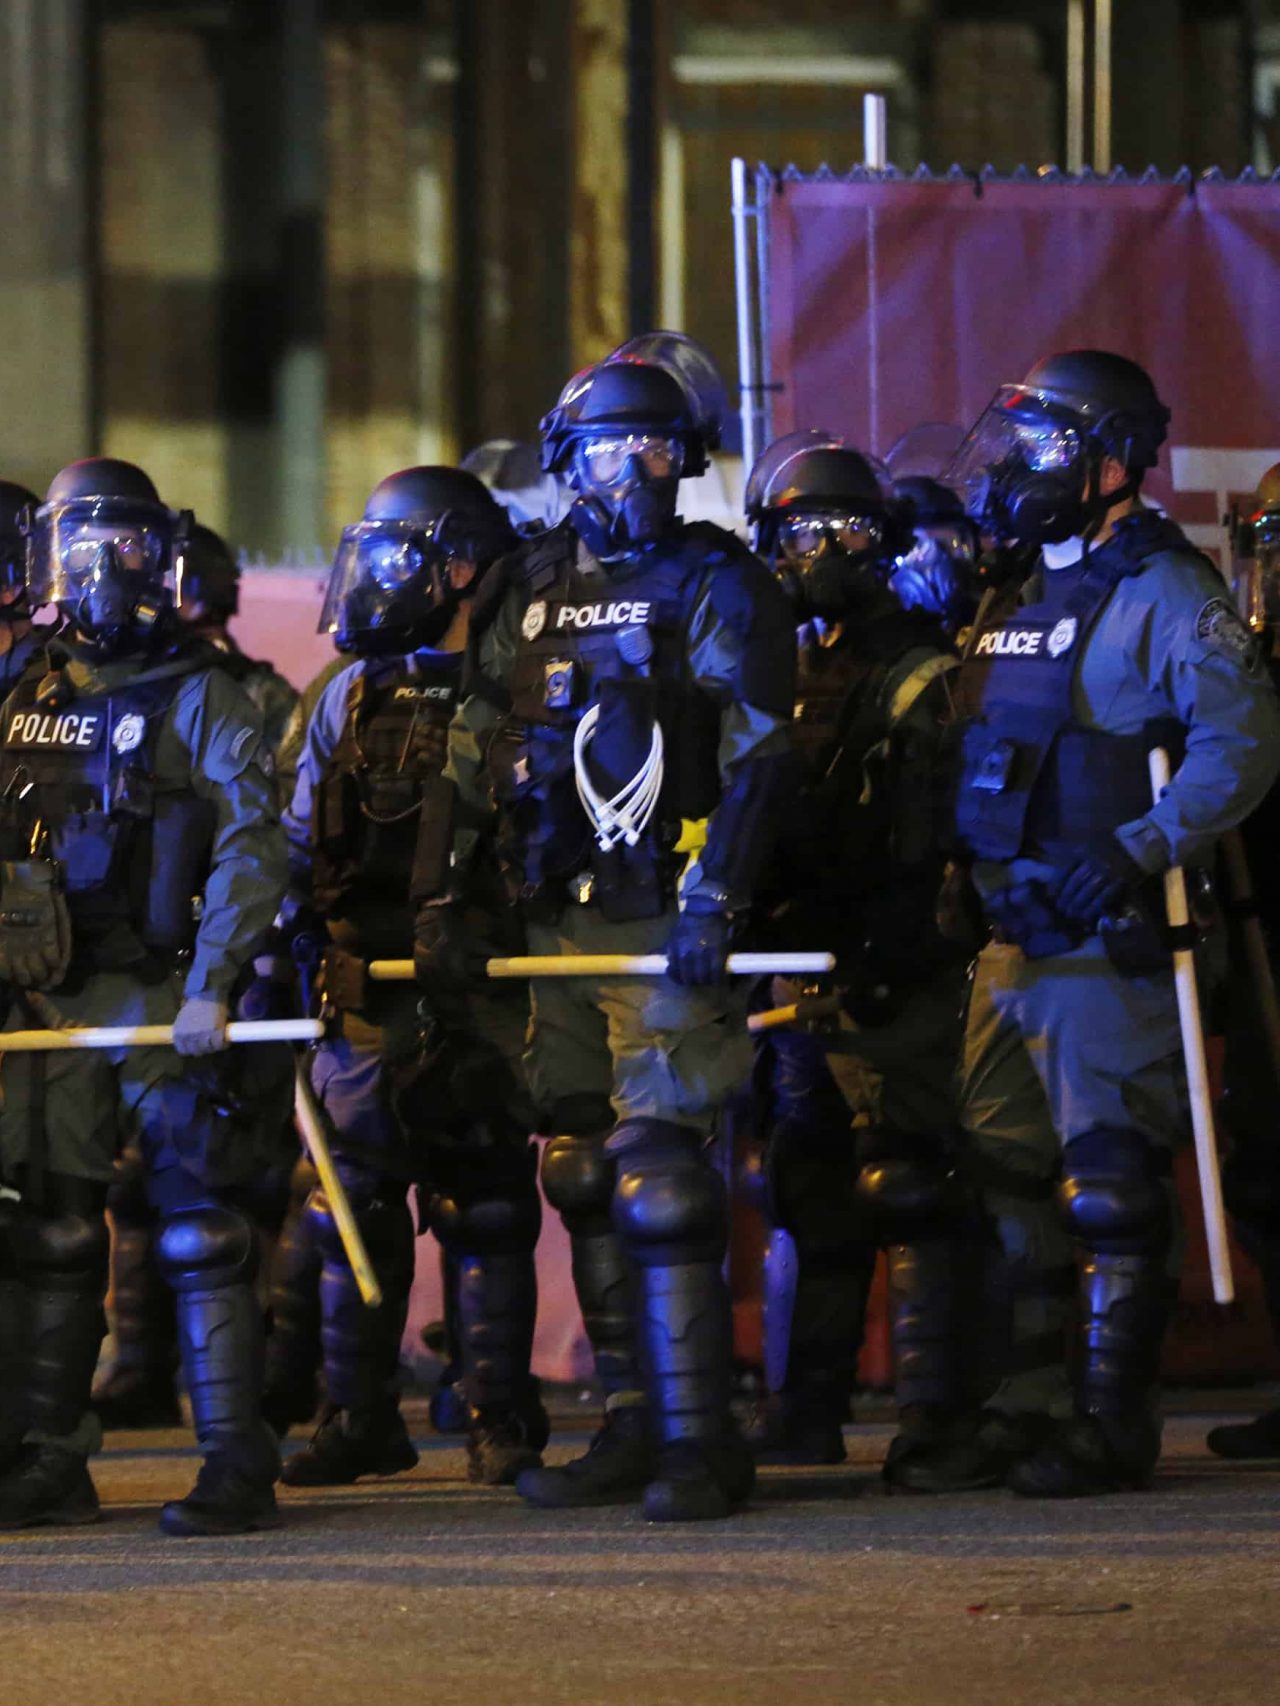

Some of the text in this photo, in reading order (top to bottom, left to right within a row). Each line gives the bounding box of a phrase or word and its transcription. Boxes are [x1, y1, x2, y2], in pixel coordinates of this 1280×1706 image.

[557, 601, 650, 628] POLICE
[975, 631, 1043, 655] POLICE
[394, 687, 452, 700] POICE
[7, 713, 98, 745] POLICE
